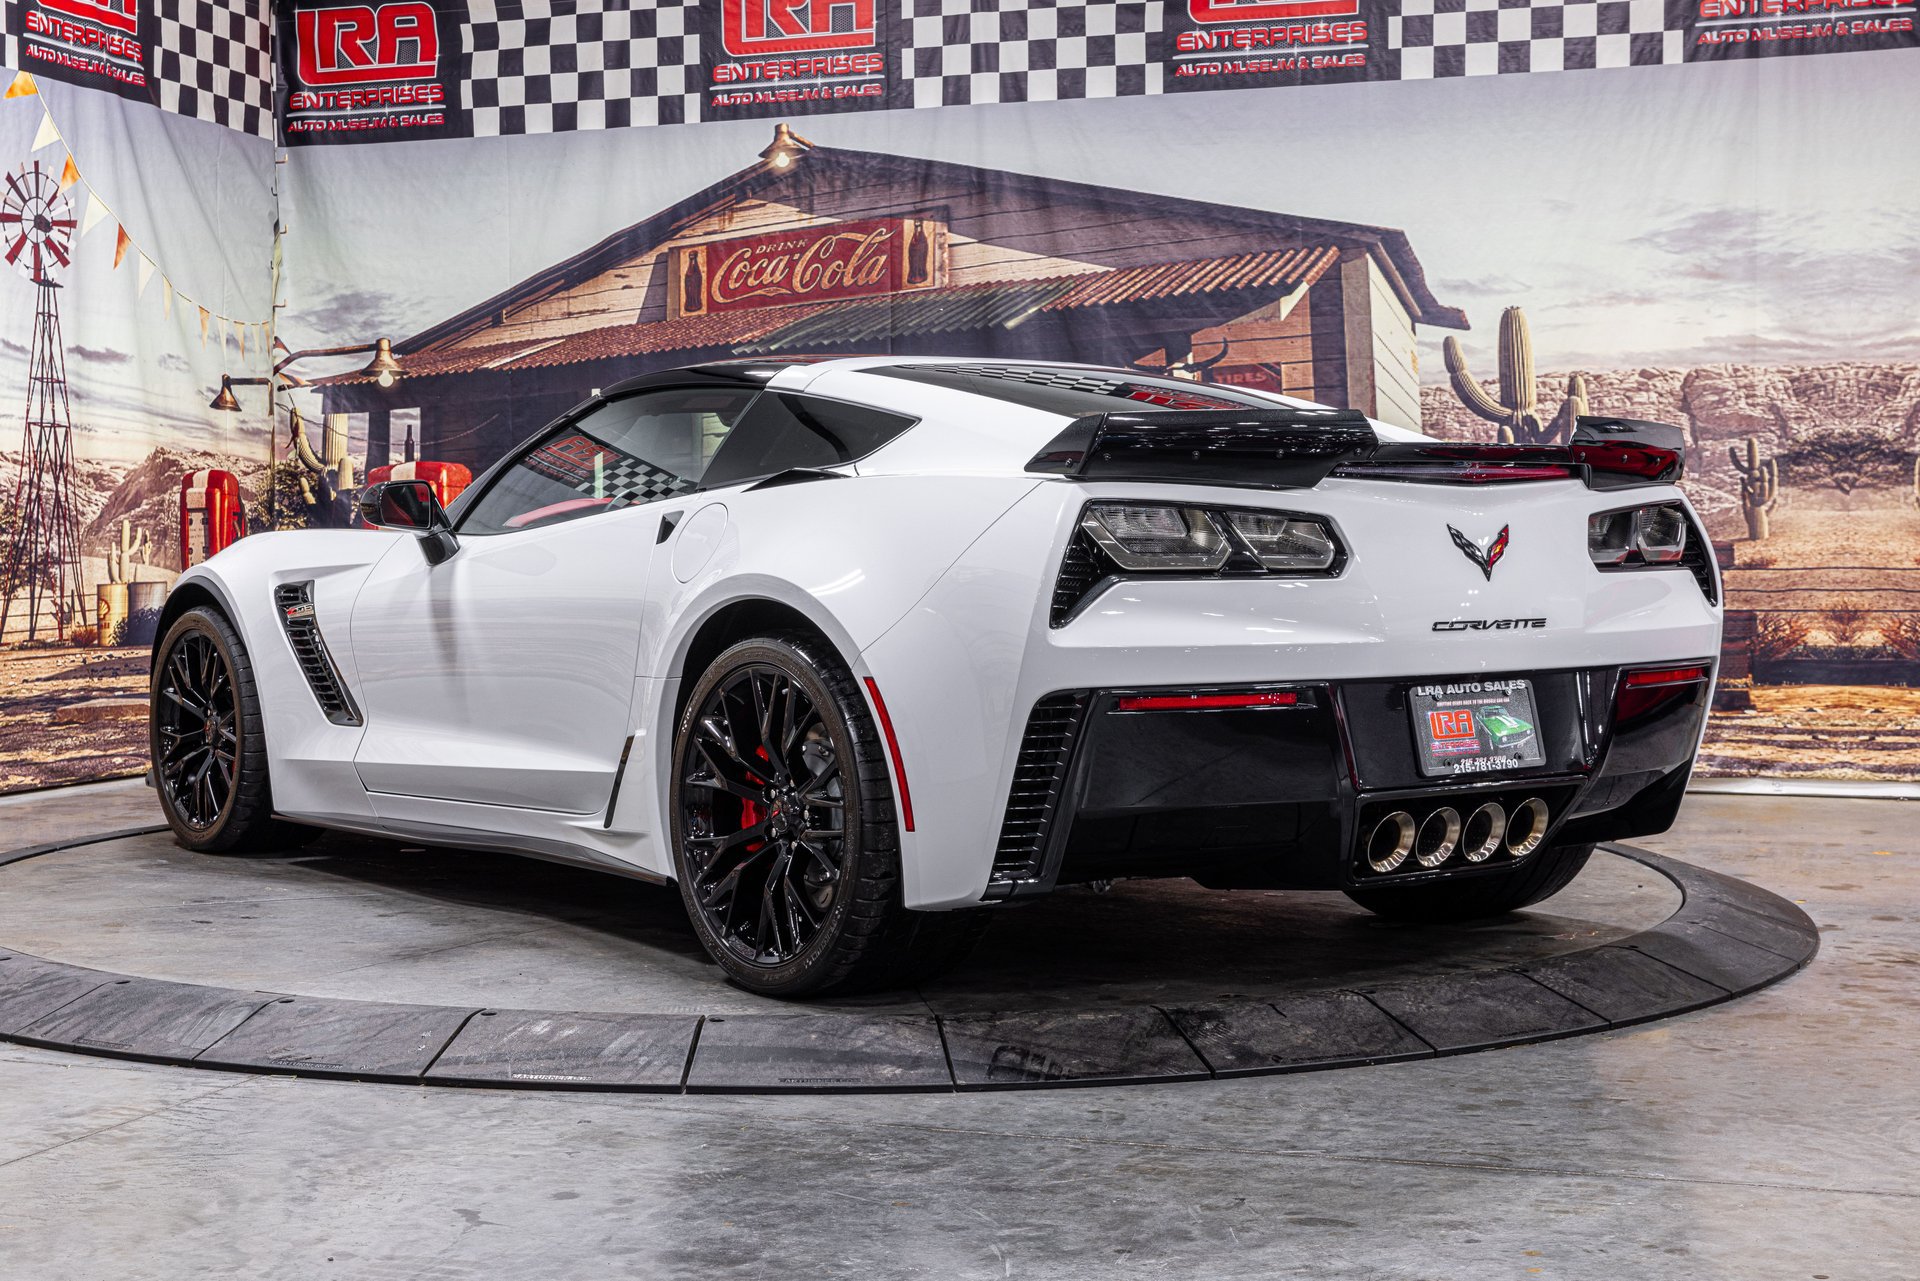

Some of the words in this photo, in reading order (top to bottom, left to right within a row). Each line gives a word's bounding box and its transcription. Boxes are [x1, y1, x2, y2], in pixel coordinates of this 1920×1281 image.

[25, 10, 143, 62] ENTERPRISES
[294, 1, 439, 86] LRA
[1176, 21, 1368, 50] ENTERPRISES
[1696, 29, 1749, 45] AUTO
[1751, 24, 1832, 41] MUSEUM
[1836, 21, 1848, 36] &
[1851, 18, 1913, 34] SALES
[25, 43, 56, 63] AUTO
[57, 51, 105, 75] MUSEUM
[113, 67, 147, 87] SALES
[712, 53, 883, 83] ENTERPRISES
[1175, 63, 1221, 77] AUTO
[1223, 58, 1295, 75] MUSEUM
[1297, 56, 1310, 70] &
[1312, 53, 1366, 68] SALES
[289, 83, 445, 110] ENTERPRISES
[712, 93, 753, 107] AUTO
[755, 88, 818, 104] MUSEUM
[821, 86, 832, 99] &
[834, 84, 882, 98] SALES
[287, 119, 326, 133] AUTO
[327, 116, 387, 131] MUSEUM
[389, 115, 398, 128] &
[400, 112, 445, 127] SALES
[755, 238, 809, 254] DRINK
[1214, 372, 1267, 384] TIRES
[1431, 617, 1547, 632] CORVETTE
[1417, 685, 1443, 697] LRA
[1446, 682, 1481, 694] AUTO
[1484, 679, 1526, 692] SALES
[1429, 709, 1476, 740] LRA
[1453, 758, 1519, 774] 215-781-3790
